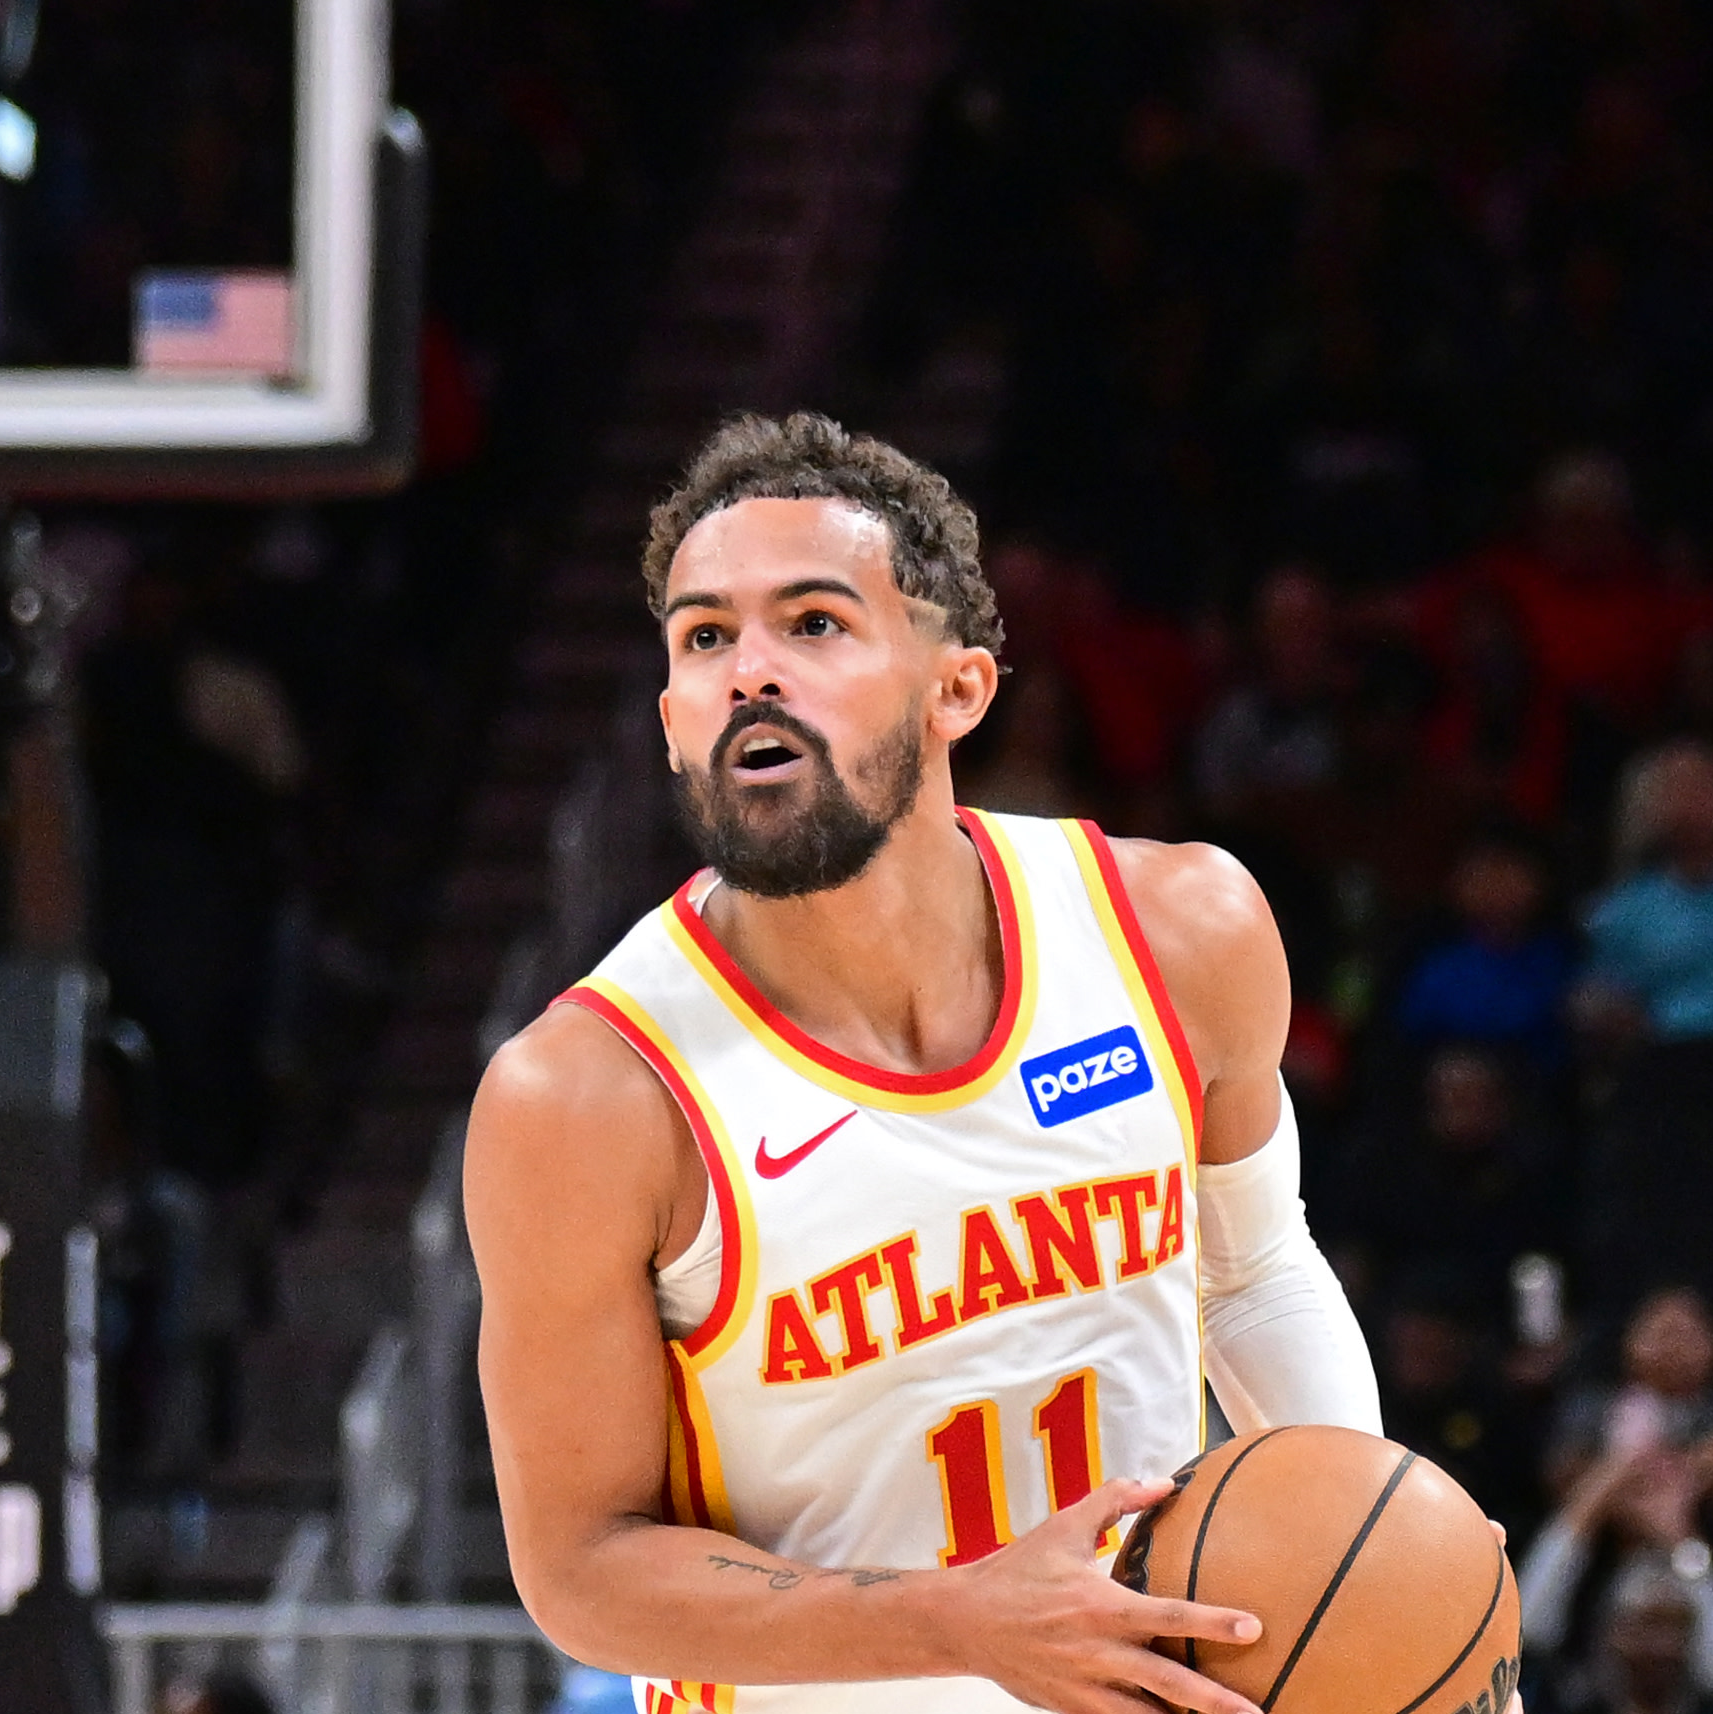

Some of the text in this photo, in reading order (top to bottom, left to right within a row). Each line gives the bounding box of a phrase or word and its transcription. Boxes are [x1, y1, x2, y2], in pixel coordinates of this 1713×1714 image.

[1030, 1045, 1139, 1113] paze
[759, 1163, 1184, 1386] ATLANTA
[925, 1366, 1122, 1568] 11
